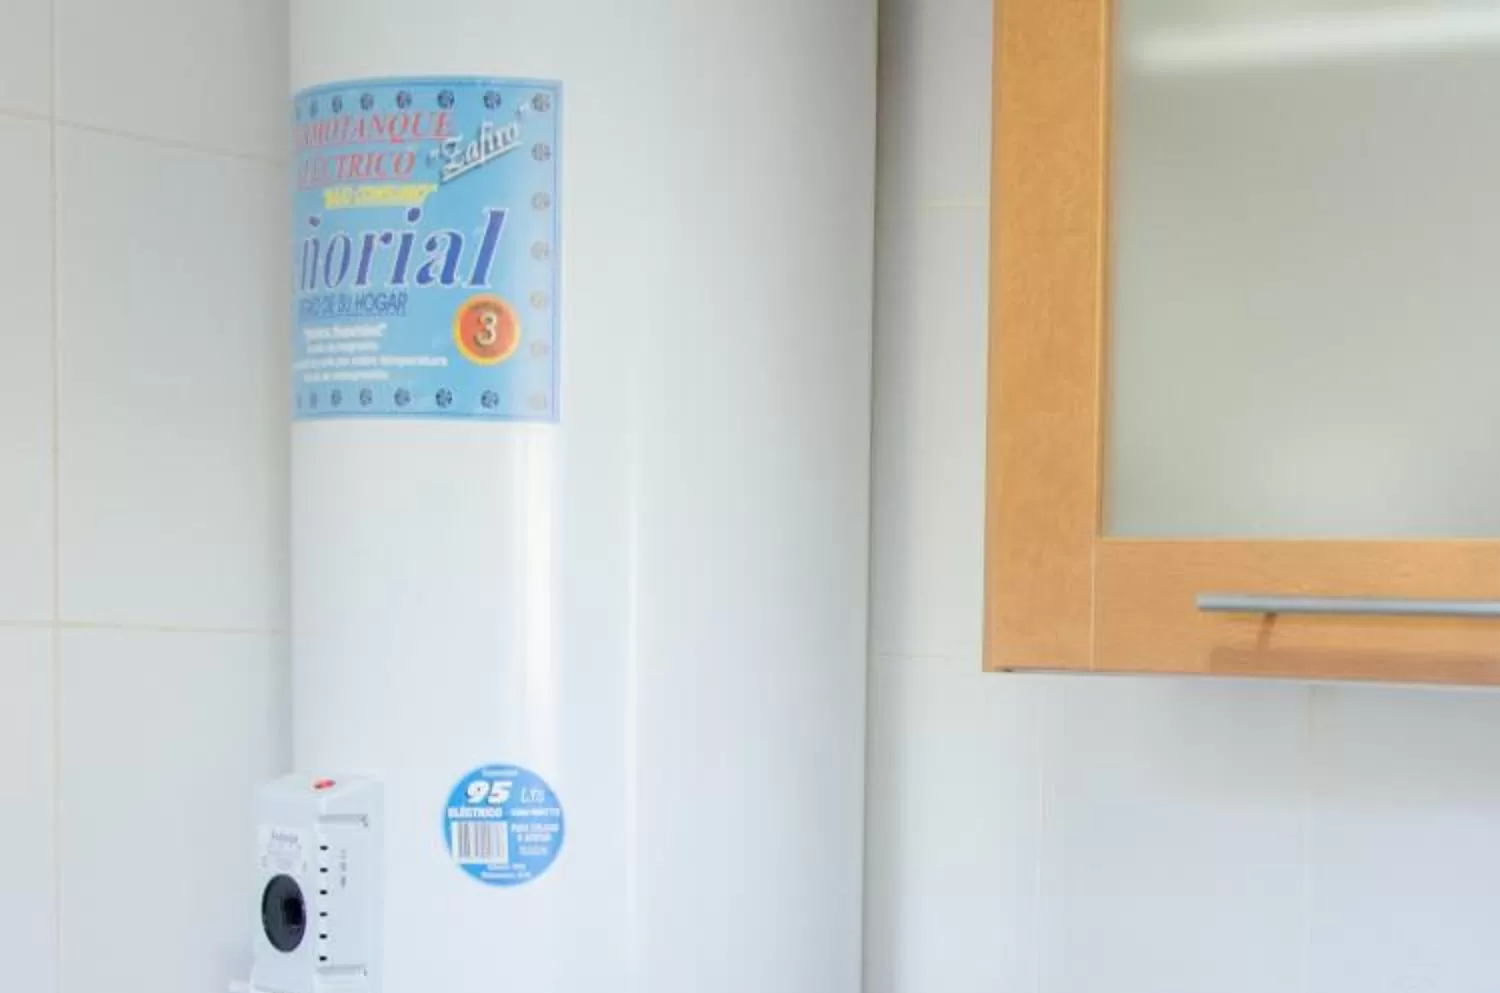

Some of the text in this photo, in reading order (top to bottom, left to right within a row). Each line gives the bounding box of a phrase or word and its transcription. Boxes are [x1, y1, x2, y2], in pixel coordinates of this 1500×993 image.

[354, 290, 408, 315] HOGAR
[473, 312, 498, 347] 3
[466, 780, 512, 804] 95
